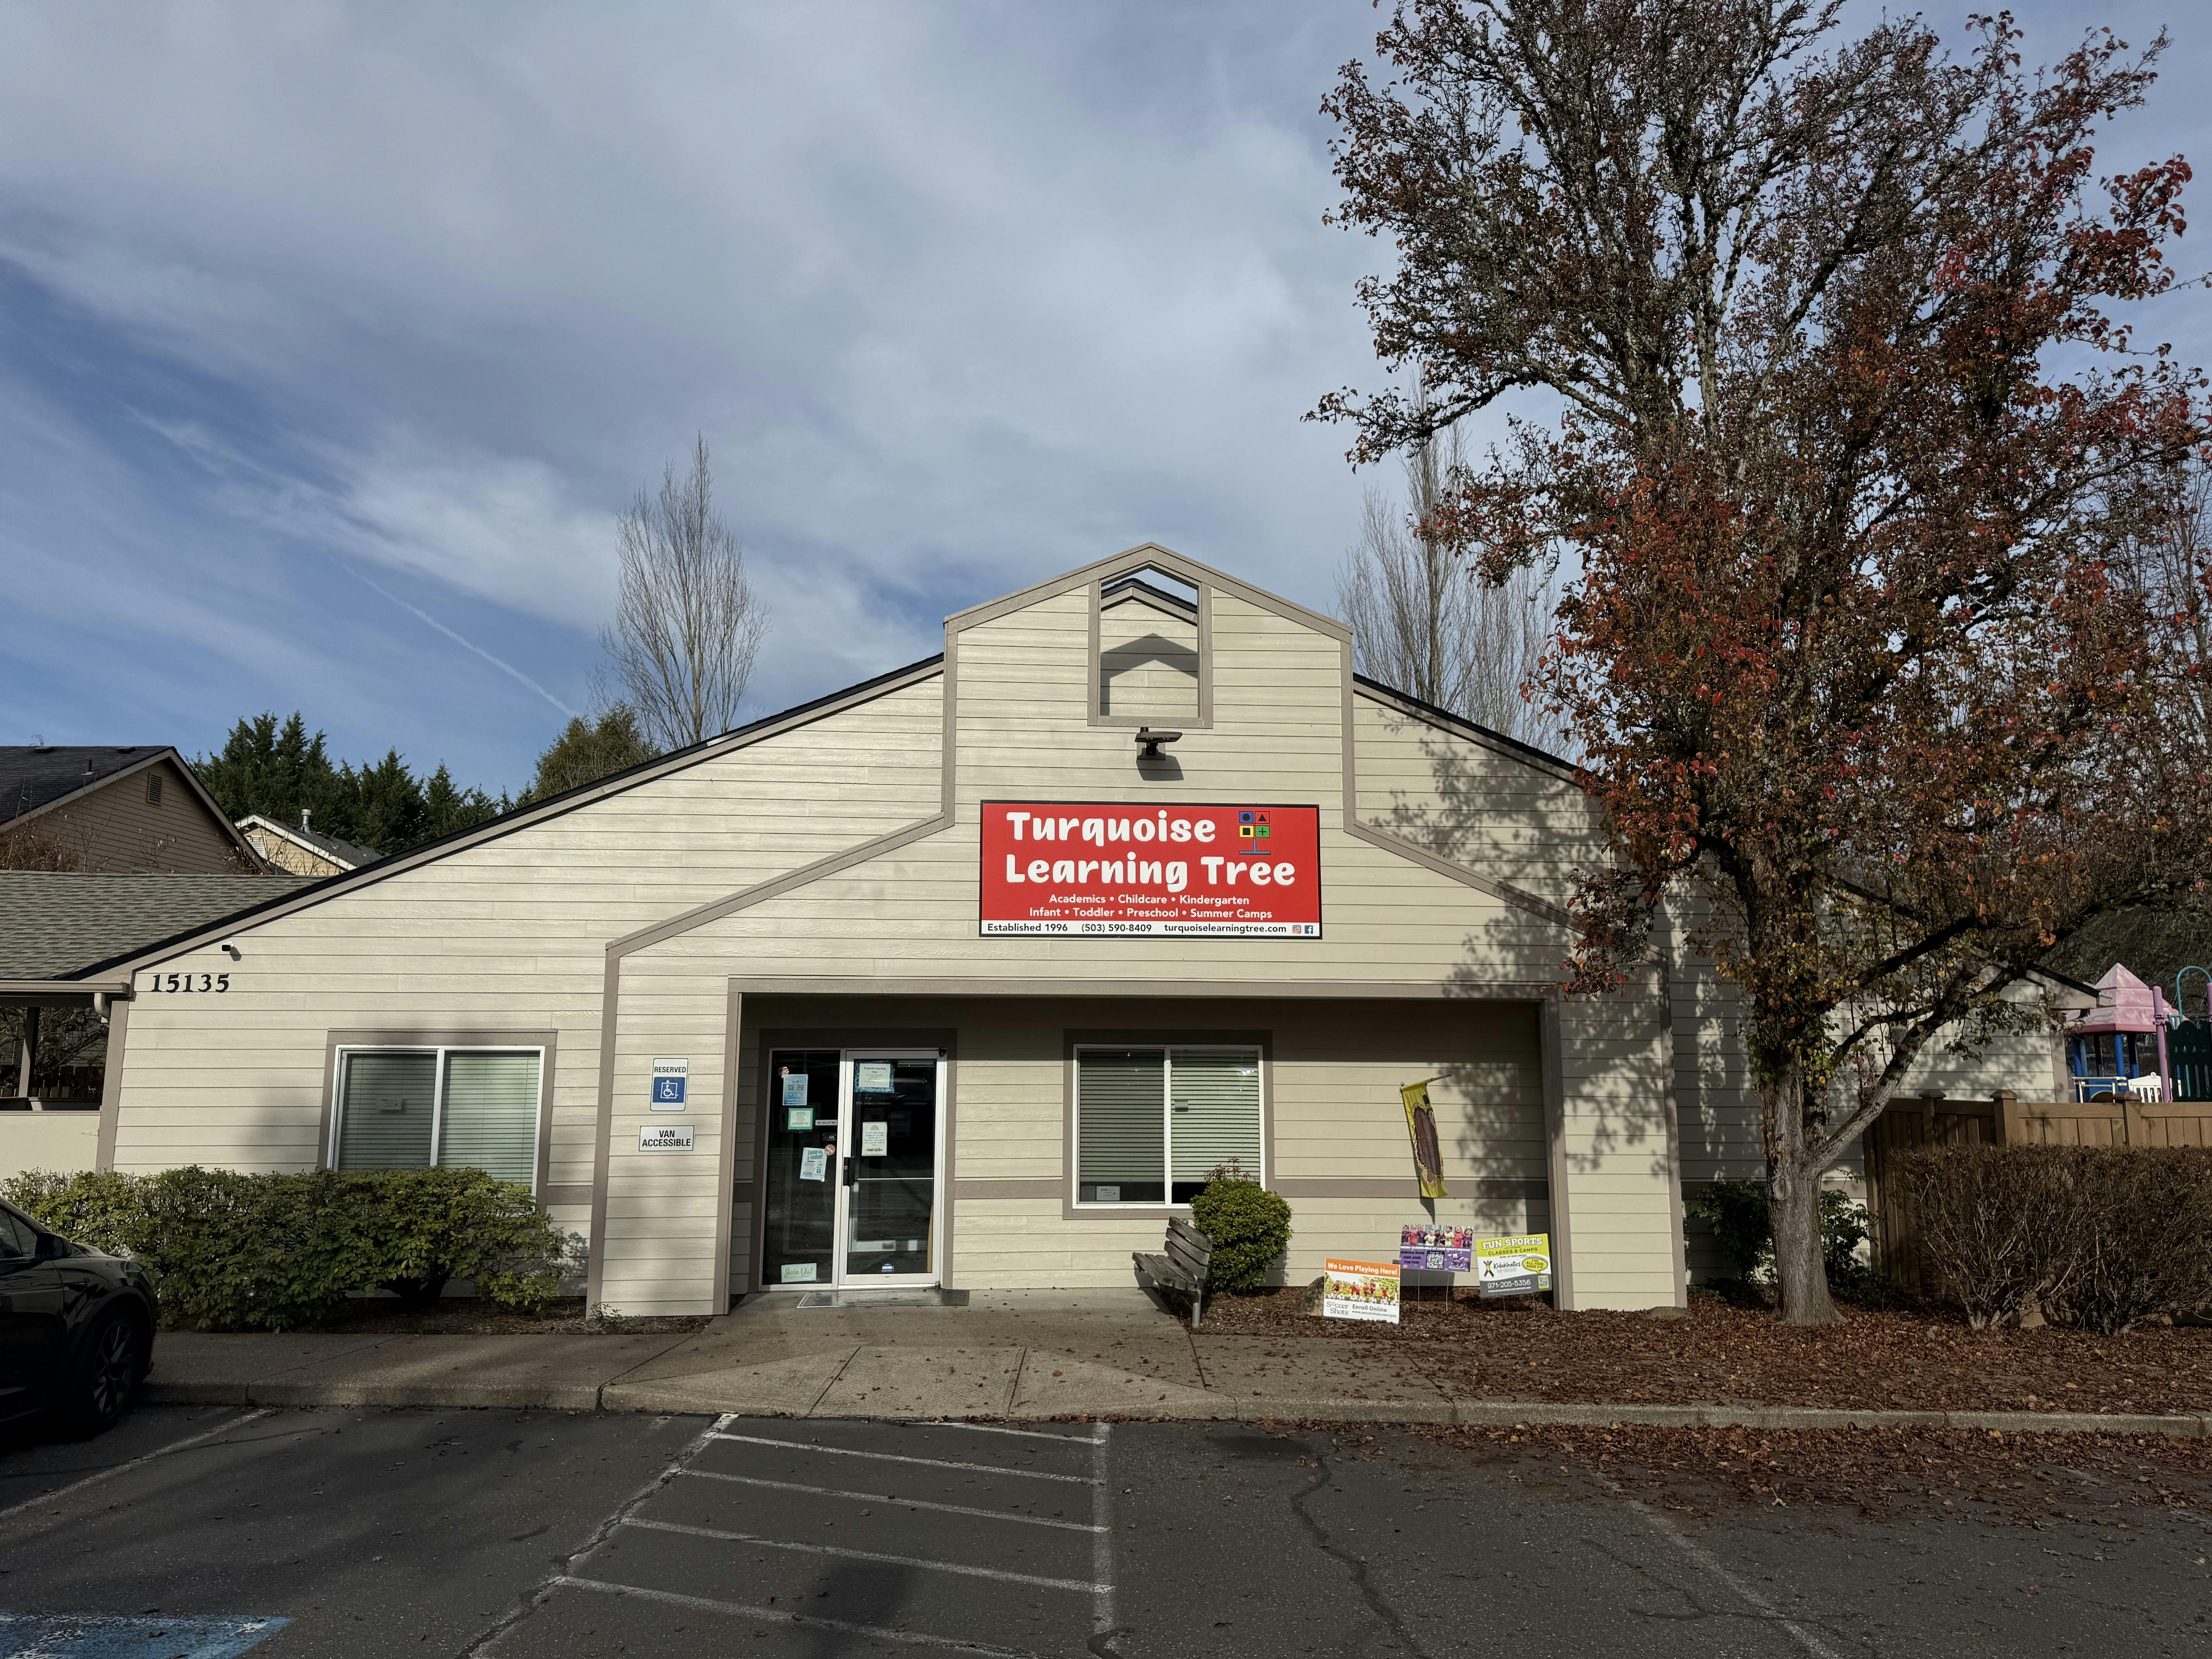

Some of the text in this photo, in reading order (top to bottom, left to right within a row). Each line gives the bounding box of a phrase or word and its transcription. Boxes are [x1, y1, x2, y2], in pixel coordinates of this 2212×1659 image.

[1006, 810, 1215, 847] Turquoise
[1006, 852, 1295, 892] Learning Tree
[1049, 894, 1250, 907] Academics Childcare Kindergarten
[1030, 907, 1272, 920] Infant Toddler Preschool Summer Camps
[1082, 924, 1105, 933] (503)
[1164, 924, 1286, 934] turquoiselearningtree.com
[151, 973, 229, 993] 15135
[642, 1139, 691, 1147] ACCESSIBLE
[1482, 1237, 1542, 1250] FUN SPORTS
[784, 1267, 813, 1278] Join Us!
[1355, 1265, 1379, 1274] Playing
[1380, 1267, 1398, 1275] Here!
[1487, 1279, 1531, 1289] 971-205-5356
